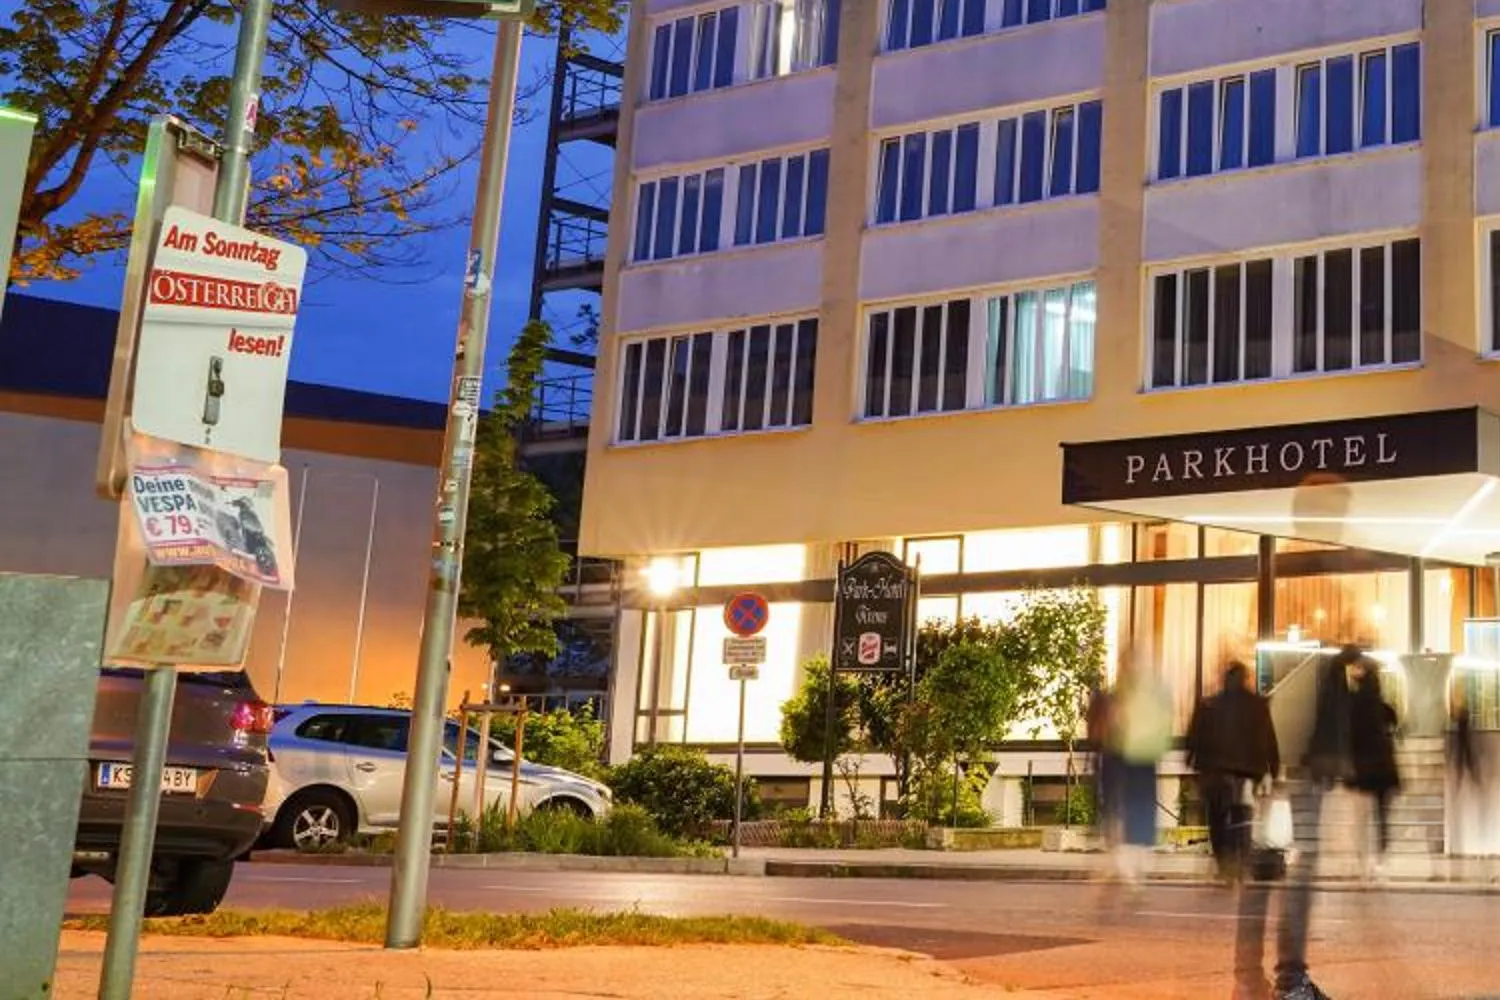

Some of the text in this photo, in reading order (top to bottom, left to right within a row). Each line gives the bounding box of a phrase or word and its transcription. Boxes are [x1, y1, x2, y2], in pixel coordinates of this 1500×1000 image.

[163, 225, 281, 271] Am Sonntag
[153, 271, 295, 311] ÖSTERREICH
[228, 328, 285, 357] lesen!
[1125, 433, 1397, 484] PARKHOTEL
[133, 476, 185, 494] Deine
[136, 494, 197, 513] VESPA
